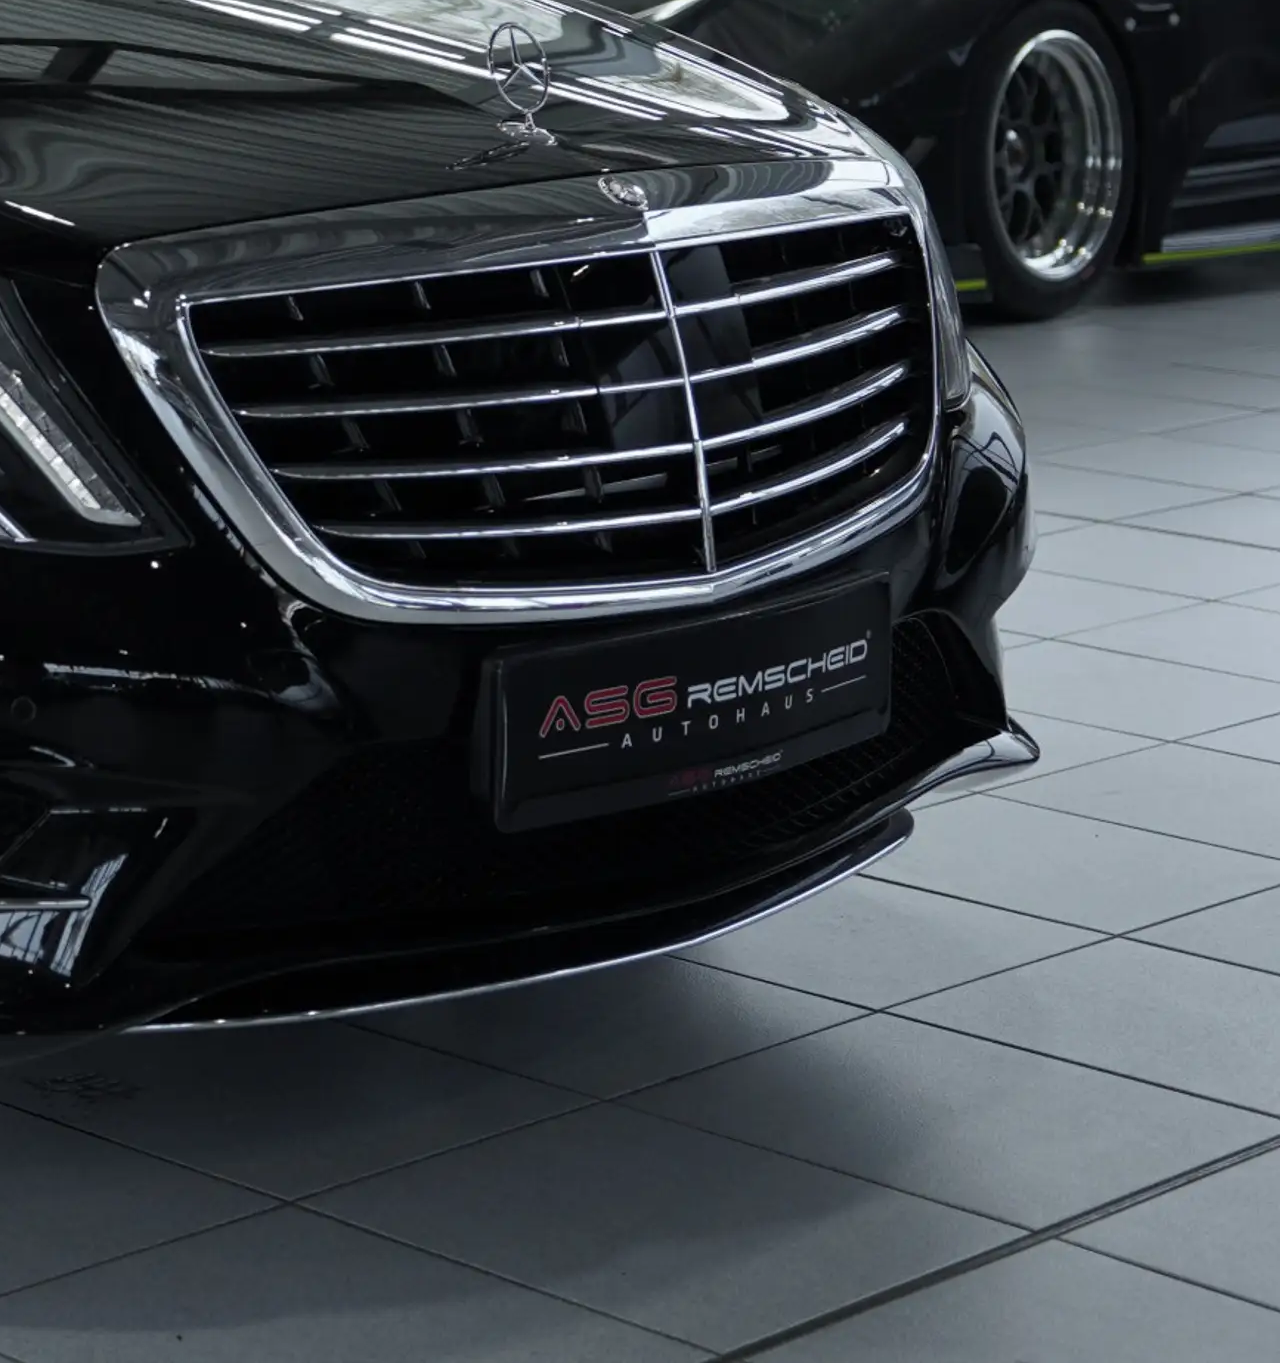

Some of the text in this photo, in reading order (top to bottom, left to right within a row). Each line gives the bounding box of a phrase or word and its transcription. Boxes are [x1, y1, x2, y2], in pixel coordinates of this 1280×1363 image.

[539, 639, 869, 738] ASG REMSCHEID
[621, 688, 815, 749] AUTOHAUS
